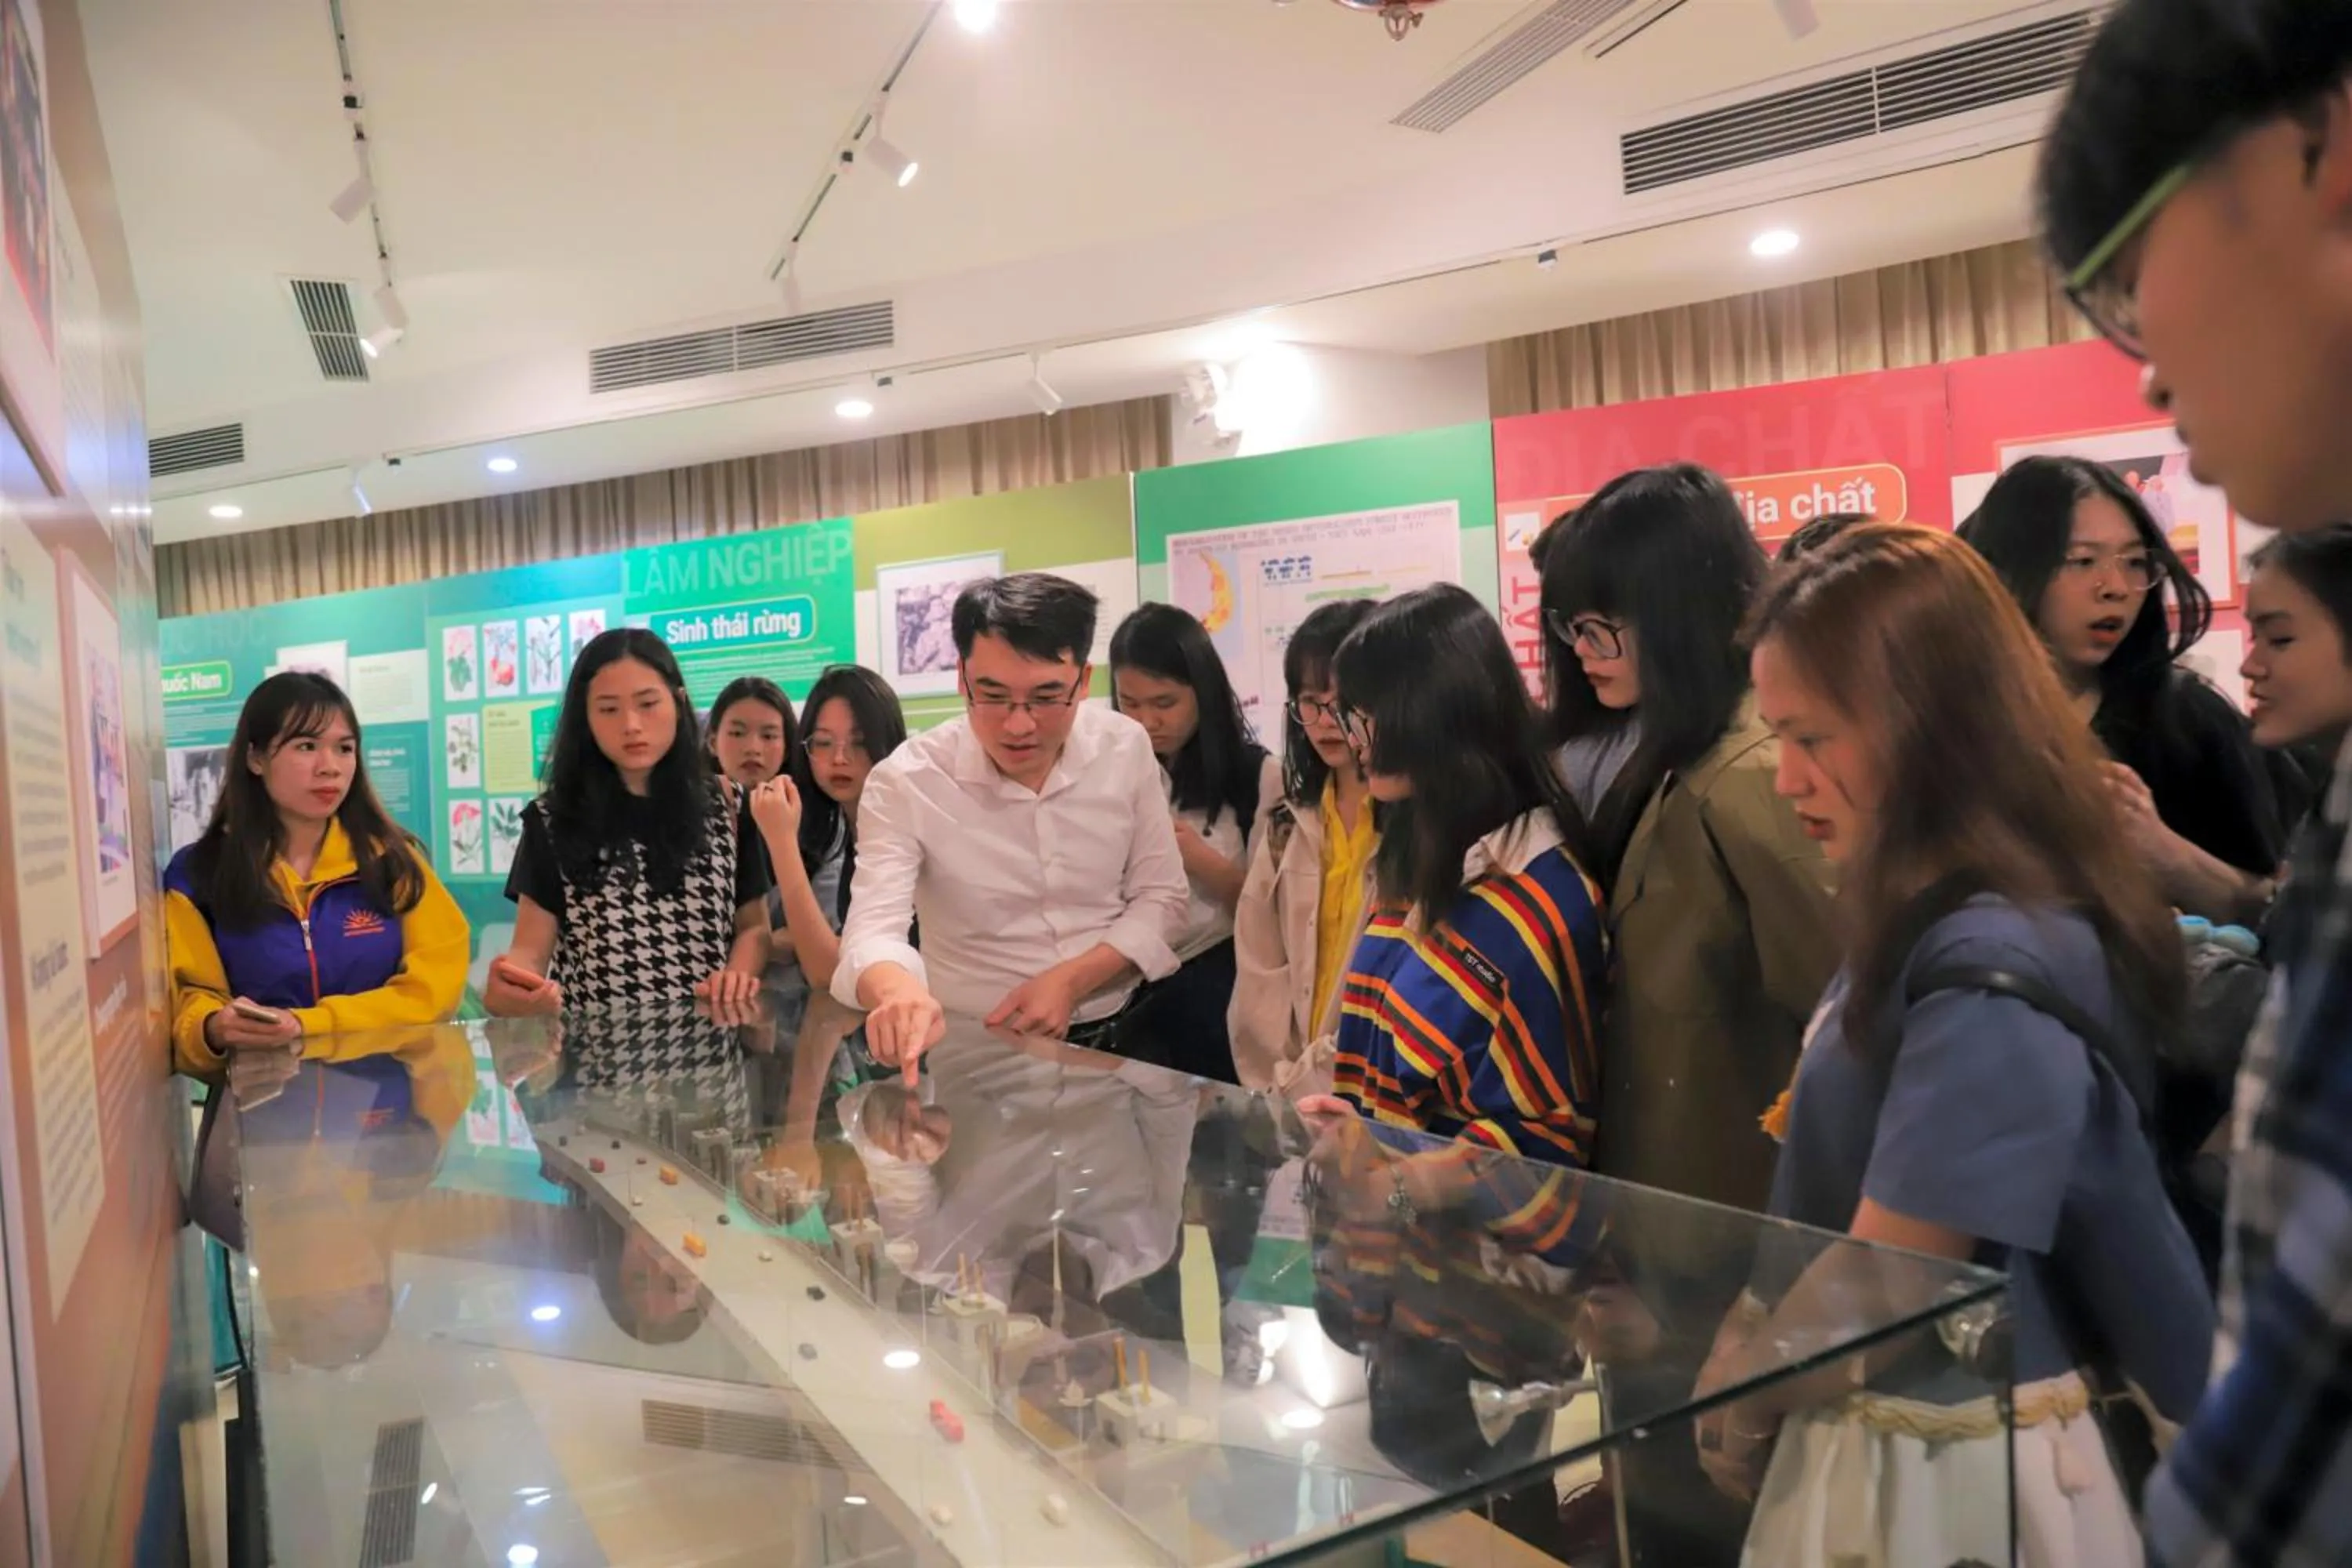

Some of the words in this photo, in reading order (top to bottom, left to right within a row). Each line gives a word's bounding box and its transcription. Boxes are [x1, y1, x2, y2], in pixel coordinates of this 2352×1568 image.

[1790, 476, 1878, 520] chất
[624, 546, 700, 599] LÂM
[708, 521, 852, 589] NGHIỆP
[666, 616, 708, 644] Sinh
[711, 611, 749, 640] thái
[753, 608, 802, 637] rừng
[191, 672, 222, 691] Nam
